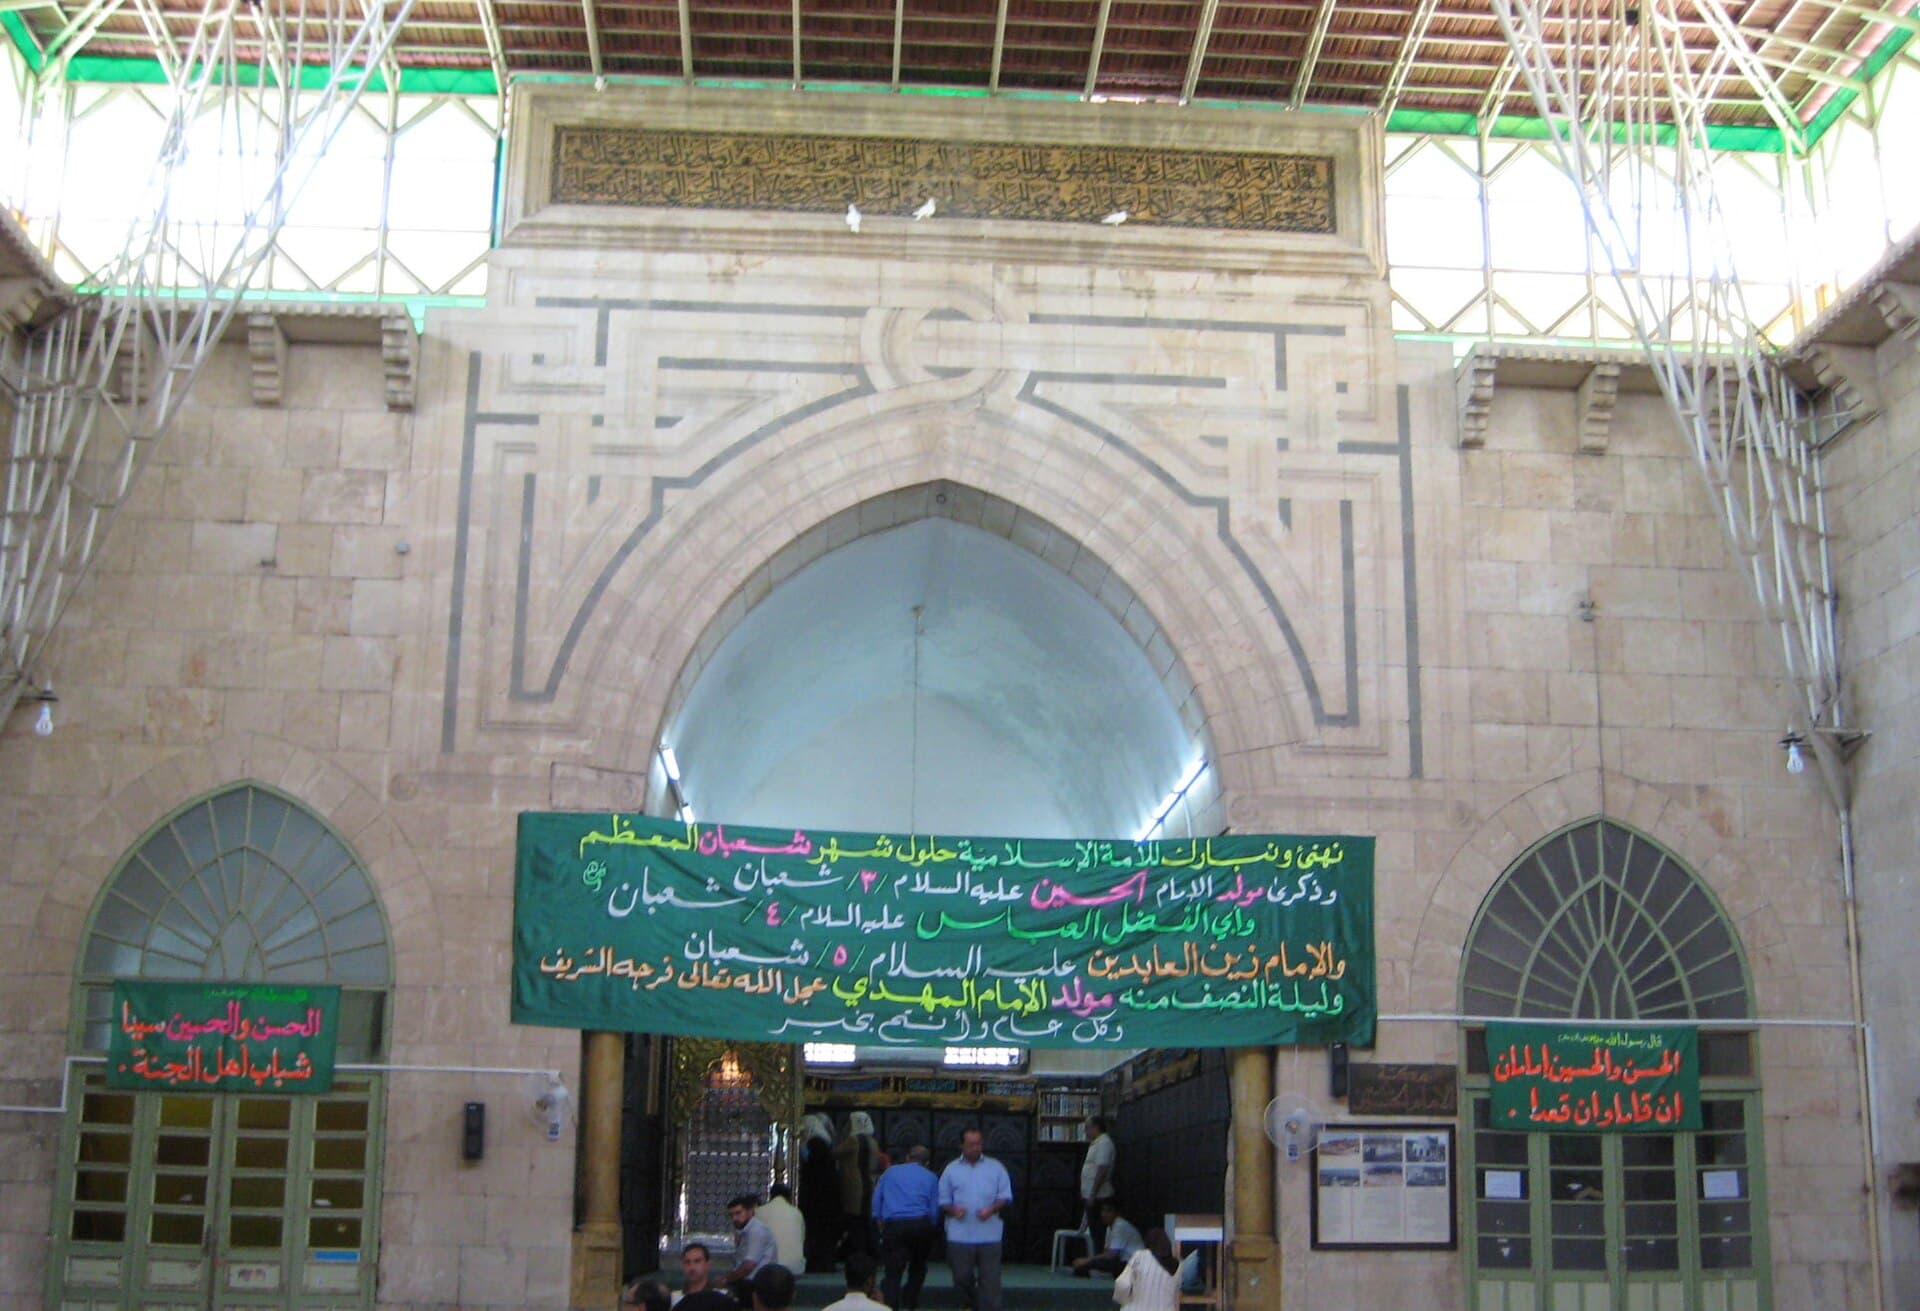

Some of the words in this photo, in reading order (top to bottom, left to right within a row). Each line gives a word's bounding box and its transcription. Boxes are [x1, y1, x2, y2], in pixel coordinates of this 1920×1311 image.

[579, 813, 699, 860] المعظم
[699, 824, 813, 859] شعبان
[806, 834, 894, 865] شهر
[896, 834, 957, 867] حلول
[957, 839, 1099, 873] الإسلامية
[1161, 838, 1292, 872] ونبارك
[607, 866, 747, 918] شعبان
[733, 856, 844, 897] شعبان
[893, 871, 970, 901] السلام
[969, 876, 1024, 905] عليه
[1030, 869, 1149, 910] الحسين
[1215, 873, 1265, 907] مولد
[800, 902, 862, 932] السلام
[860, 904, 906, 935] عليه
[916, 904, 1101, 946] العباس
[1102, 902, 1209, 945] الفضل
[683, 928, 810, 967] شعبان
[868, 940, 983, 986] السلام
[1087, 940, 1199, 985] العابدين
[1200, 943, 1261, 981] زين
[613, 954, 676, 991] فرجه
[732, 965, 783, 996] الله
[782, 974, 829, 1007] عجل
[831, 974, 977, 1014] المهدي
[1051, 975, 1115, 1018] مولد
[1118, 986, 1170, 1011] منه
[1171, 978, 1267, 1013] النصف
[1267, 980, 1345, 1018] وليلة
[165, 1000, 250, 1041] والحسين
[251, 1007, 322, 1041] الحسن
[767, 1010, 876, 1034] بخير
[992, 1011, 1064, 1045] عام
[1071, 1009, 1124, 1043] وكل
[249, 1047, 313, 1087] شباب
[1548, 1046, 1623, 1084] والحسين
[1622, 1048, 1681, 1085] الحسن
